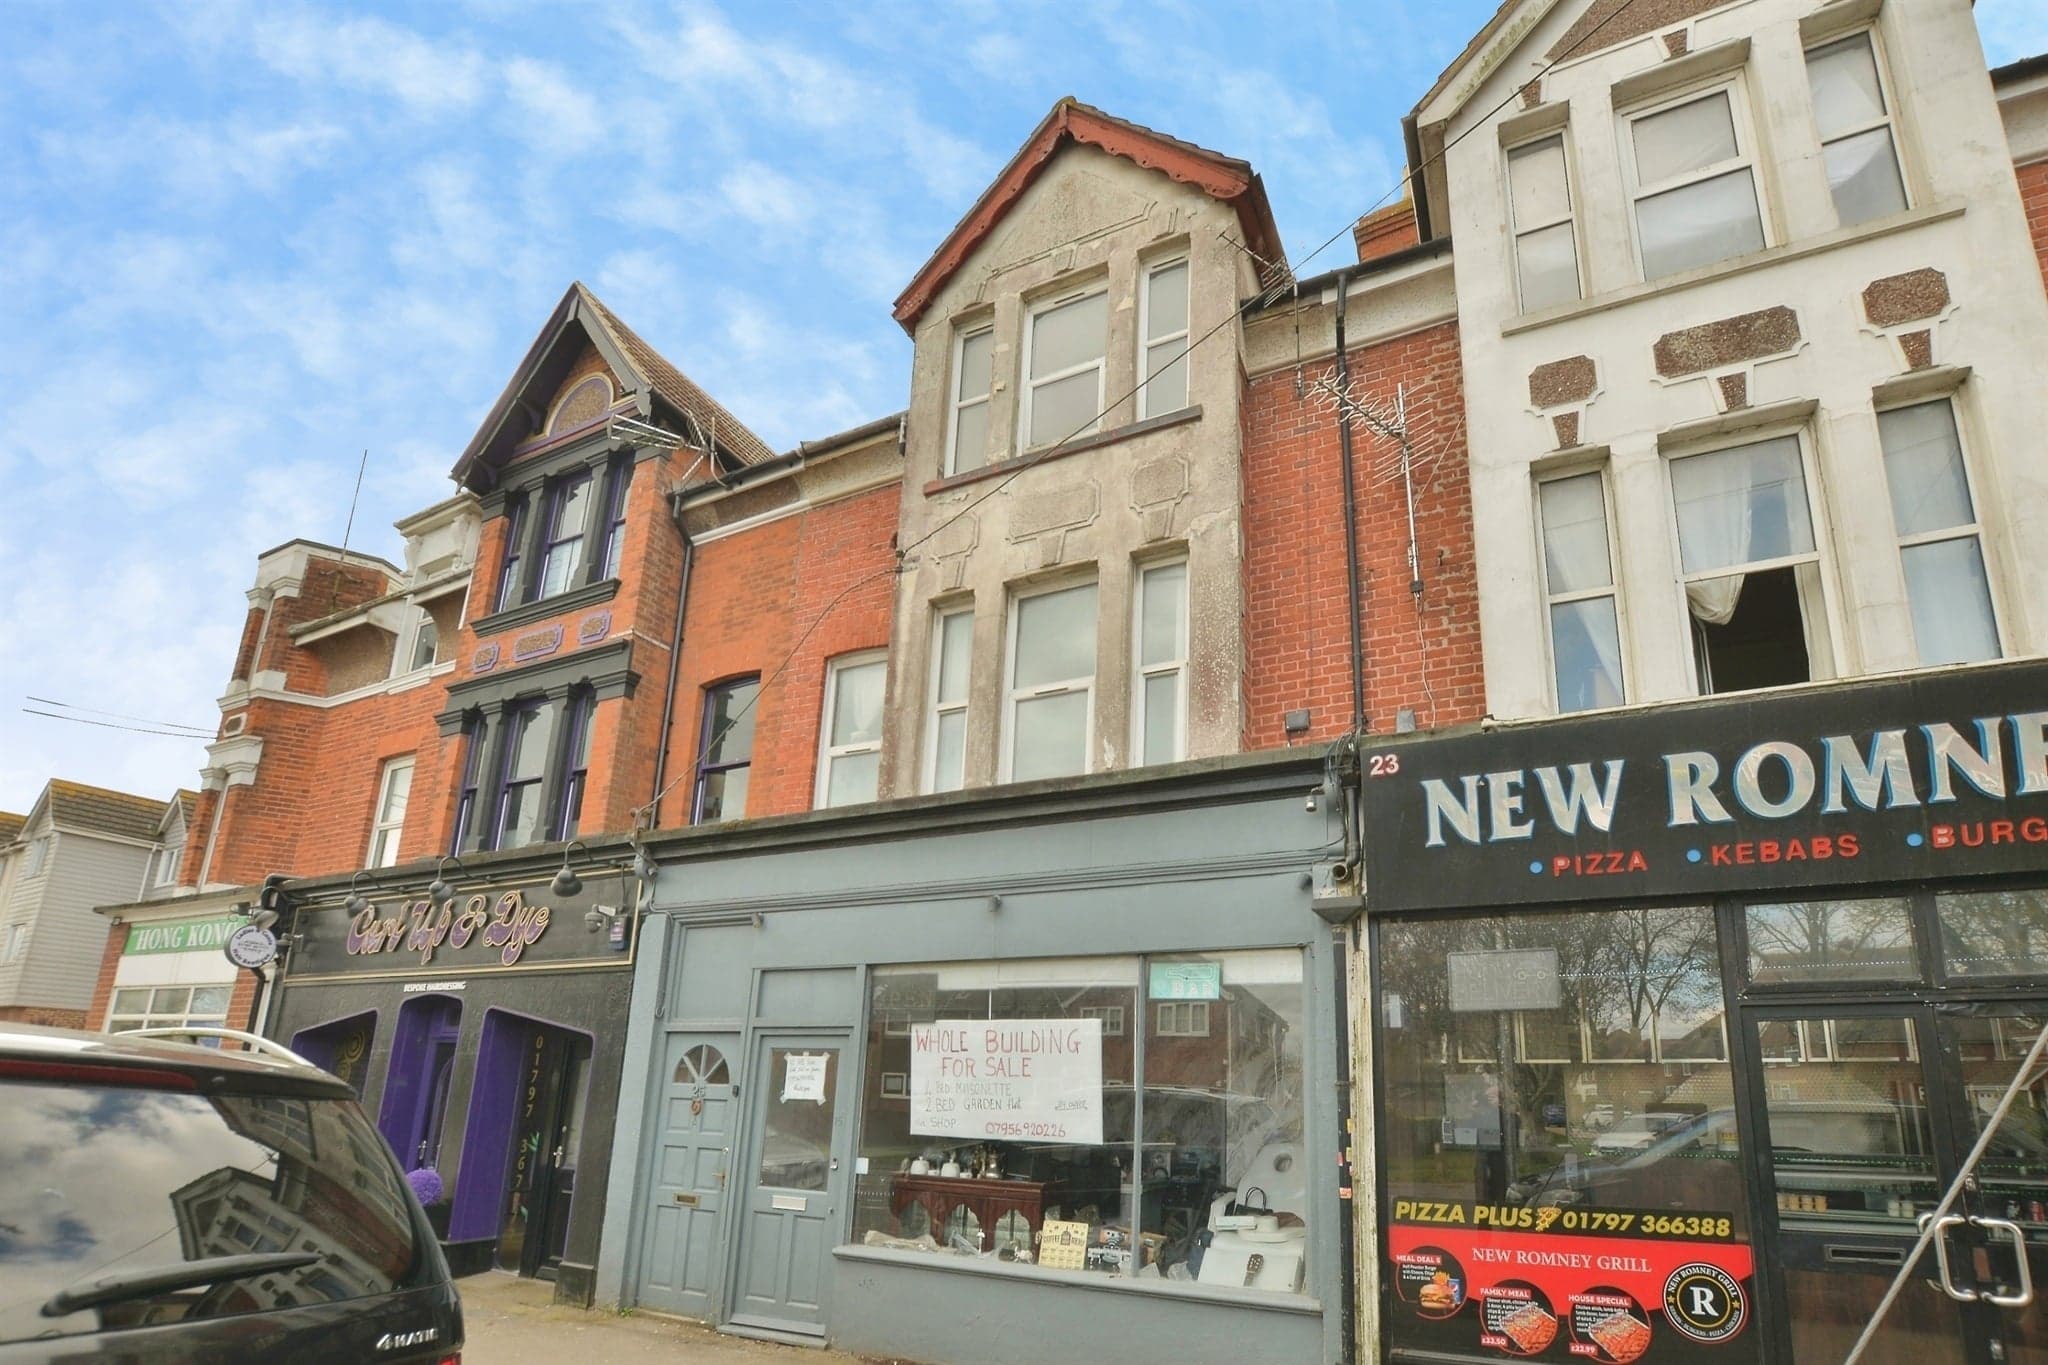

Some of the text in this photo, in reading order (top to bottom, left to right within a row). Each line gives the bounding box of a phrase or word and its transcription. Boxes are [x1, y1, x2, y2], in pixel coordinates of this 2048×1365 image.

[1369, 753, 1400, 776] 23
[1420, 711, 2048, 849] NEW ROMNE
[1552, 815, 2048, 878] PIZZA KEBABS BURG
[134, 926, 184, 951] HONG
[347, 890, 550, 966] Curl Up & Dye
[915, 1028, 1081, 1054] WHOLE BUILDING
[525, 1035, 544, 1118] 01797
[942, 1056, 1032, 1078] FOR SALE
[935, 1098, 955, 1112] BED
[964, 1098, 1001, 1111] GARDEN
[1395, 1201, 1731, 1237] PIZZA PLUS 01797 366388
[1396, 1255, 1416, 1263] MEAL
[1471, 1247, 1652, 1273] NEW ROMNEY GRILL
[1480, 1288, 1529, 1298] FAMILY MEAL
[1667, 1266, 1738, 1298] NEW ROMNEY GRILL
[1568, 1294, 1629, 1306] HOUSE SPECIAL
[1689, 1286, 1719, 1317] R
[376, 1328, 439, 1350] 4MATIC
